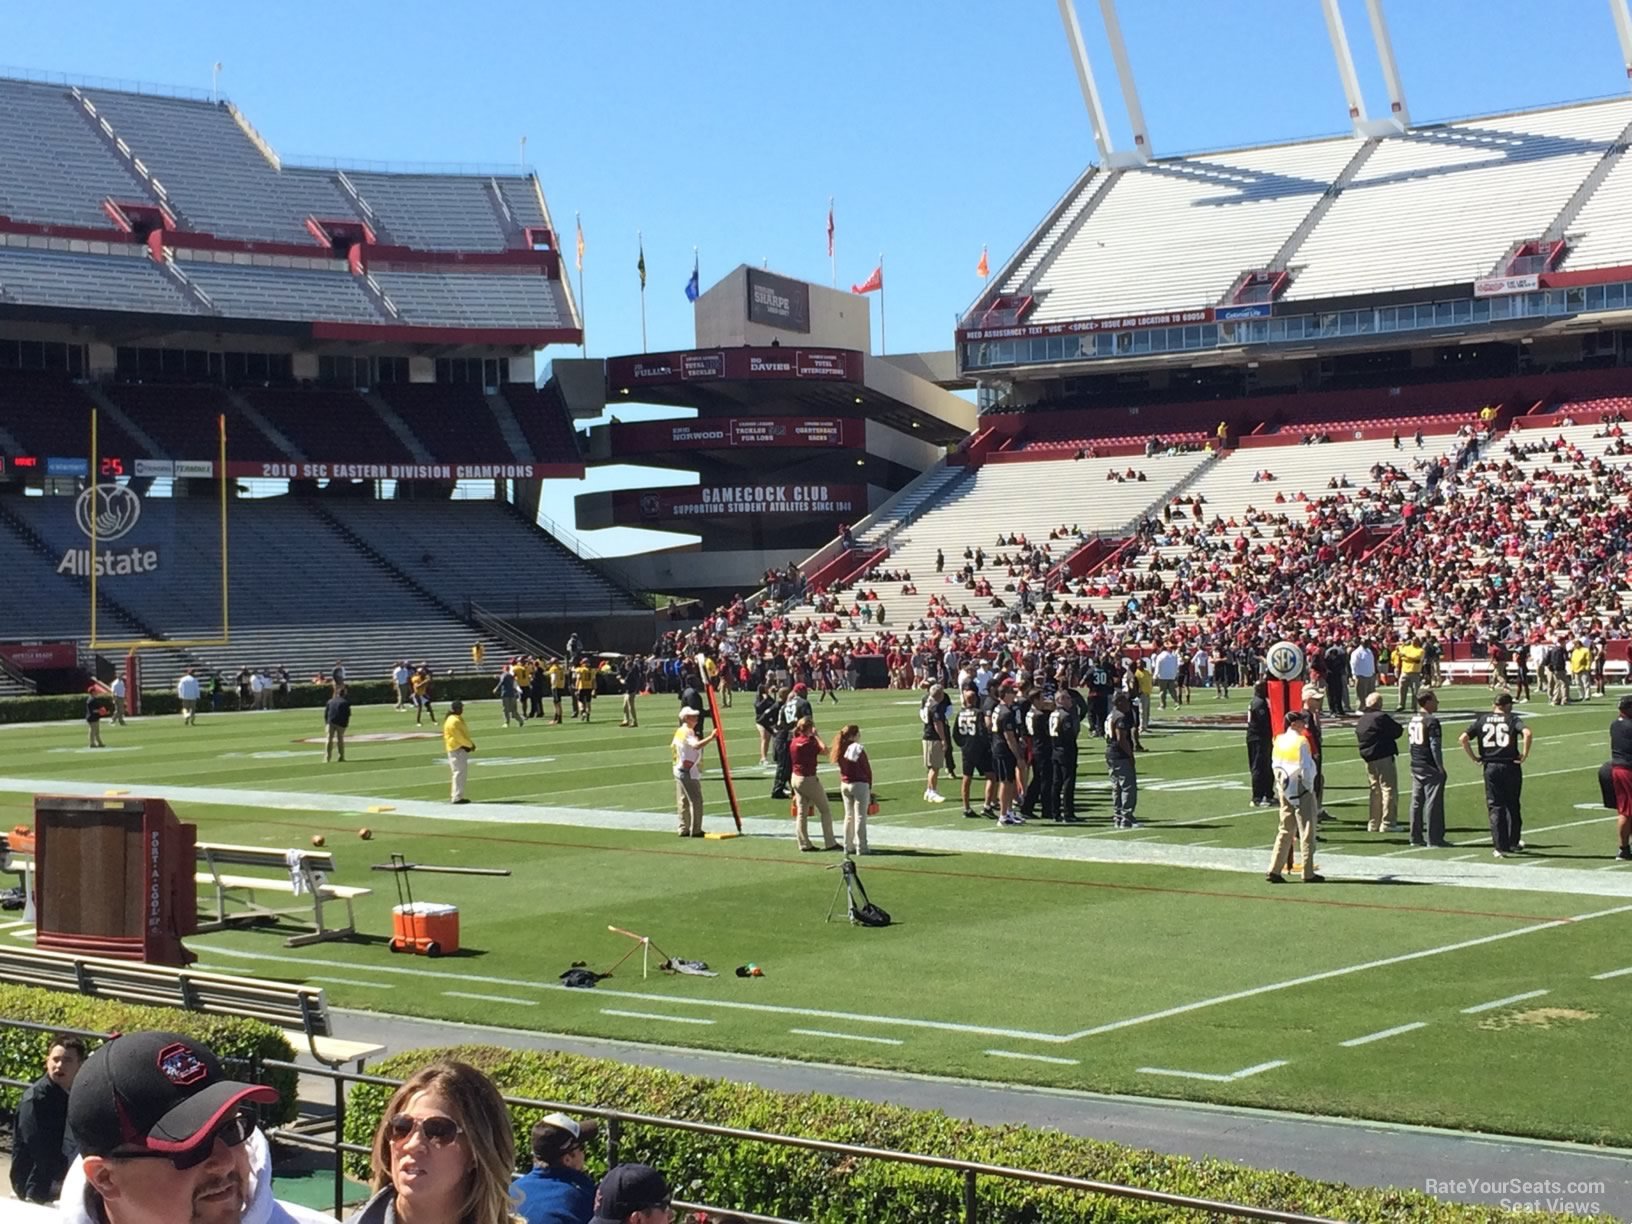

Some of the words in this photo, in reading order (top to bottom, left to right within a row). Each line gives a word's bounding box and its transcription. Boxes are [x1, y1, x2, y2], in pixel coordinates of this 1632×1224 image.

[966, 331, 983, 339] NEED
[1029, 326, 1043, 335] TEXT
[1122, 319, 1136, 327] AND
[672, 431, 724, 441] NORWOOD
[102, 457, 123, 475] 25
[263, 463, 297, 477] 2010
[303, 464, 328, 477] SEC
[333, 464, 388, 478] EASTERN
[391, 465, 451, 479] DIVISION
[456, 465, 534, 479] CHAMPIONS
[702, 486, 787, 503] GAMECOCK
[793, 486, 828, 502] CLUB
[673, 503, 725, 515] SUPPORTING
[727, 501, 767, 513] STUDENT
[769, 501, 809, 512] ATHLETES
[812, 501, 834, 512] SINCE
[56, 547, 158, 576] Allstate
[1273, 649, 1295, 671] SEC
[1093, 671, 1107, 685] 30
[958, 716, 977, 736] 55
[1408, 721, 1424, 745] 50
[1482, 723, 1510, 747] 26
